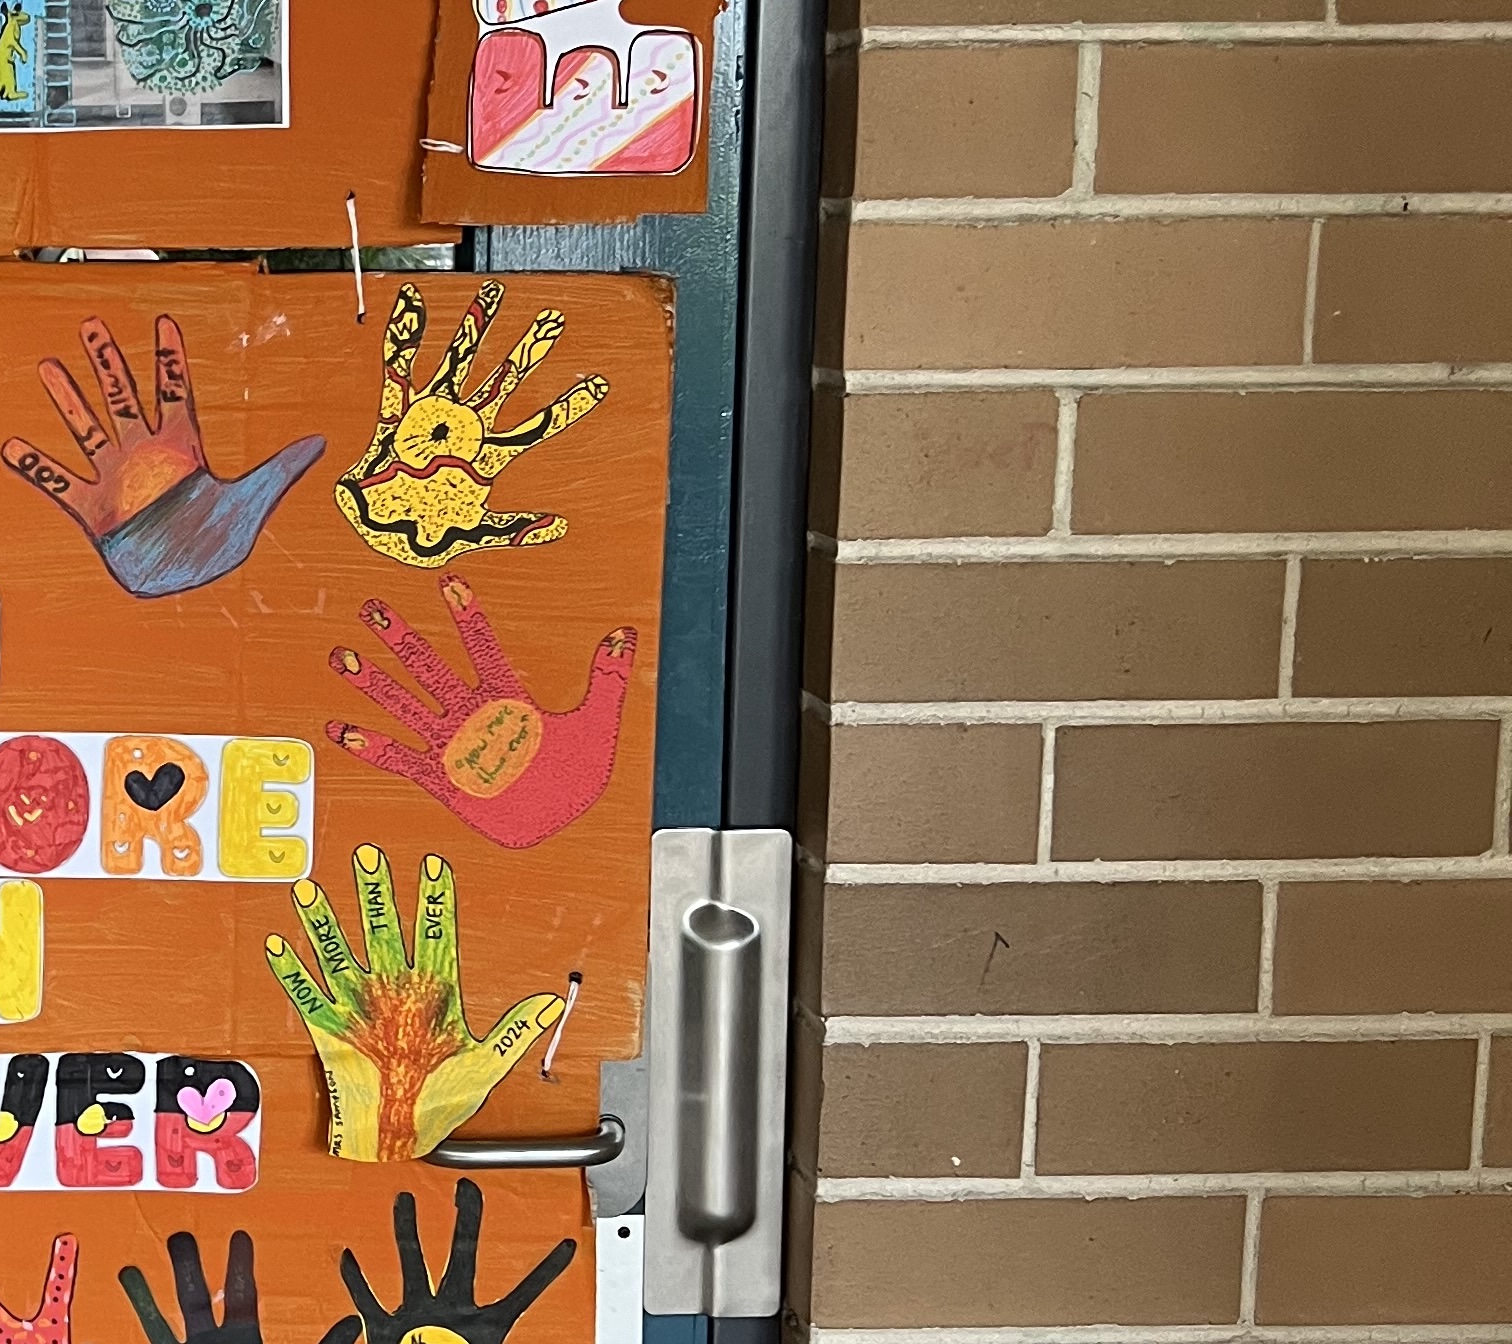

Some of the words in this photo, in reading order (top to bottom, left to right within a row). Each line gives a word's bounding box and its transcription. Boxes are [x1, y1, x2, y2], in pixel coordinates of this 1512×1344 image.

[364, 882, 388, 935] THAN
[425, 891, 445, 940] EVER
[310, 915, 349, 974] MORE
[283, 971, 323, 1015] NOW
[493, 1019, 530, 1057] 2024
